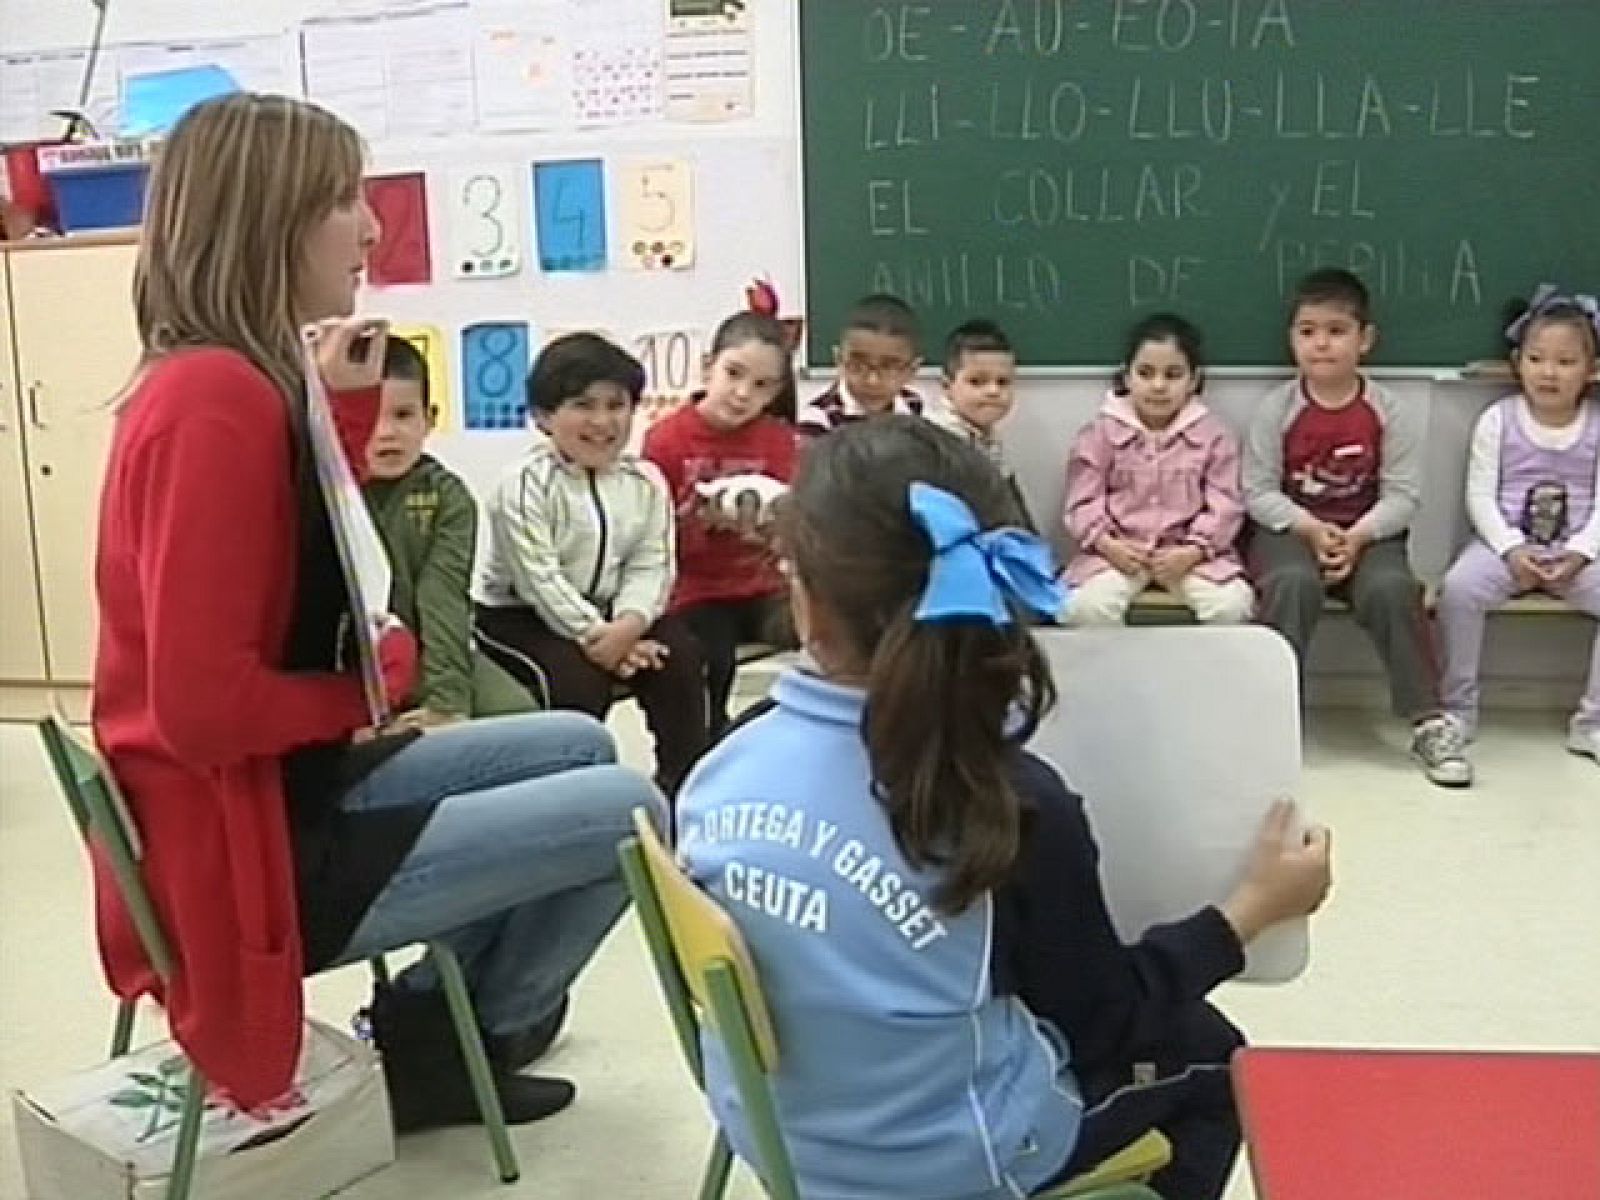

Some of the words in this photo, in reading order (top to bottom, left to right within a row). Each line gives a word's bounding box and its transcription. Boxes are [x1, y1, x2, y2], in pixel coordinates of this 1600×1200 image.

[463, 174, 504, 258] 3
[552, 177, 586, 250] 4
[639, 164, 677, 233] 5
[869, 179, 930, 235] EL
[992, 163, 1207, 227] COLLAR
[1312, 158, 1376, 219] EL
[476, 327, 517, 399] 8
[634, 331, 690, 392] 10
[704, 801, 805, 849] ORTEGA
[809, 818, 838, 858] Y
[832, 839, 948, 950] GASSET
[724, 860, 828, 932] CEUTA
